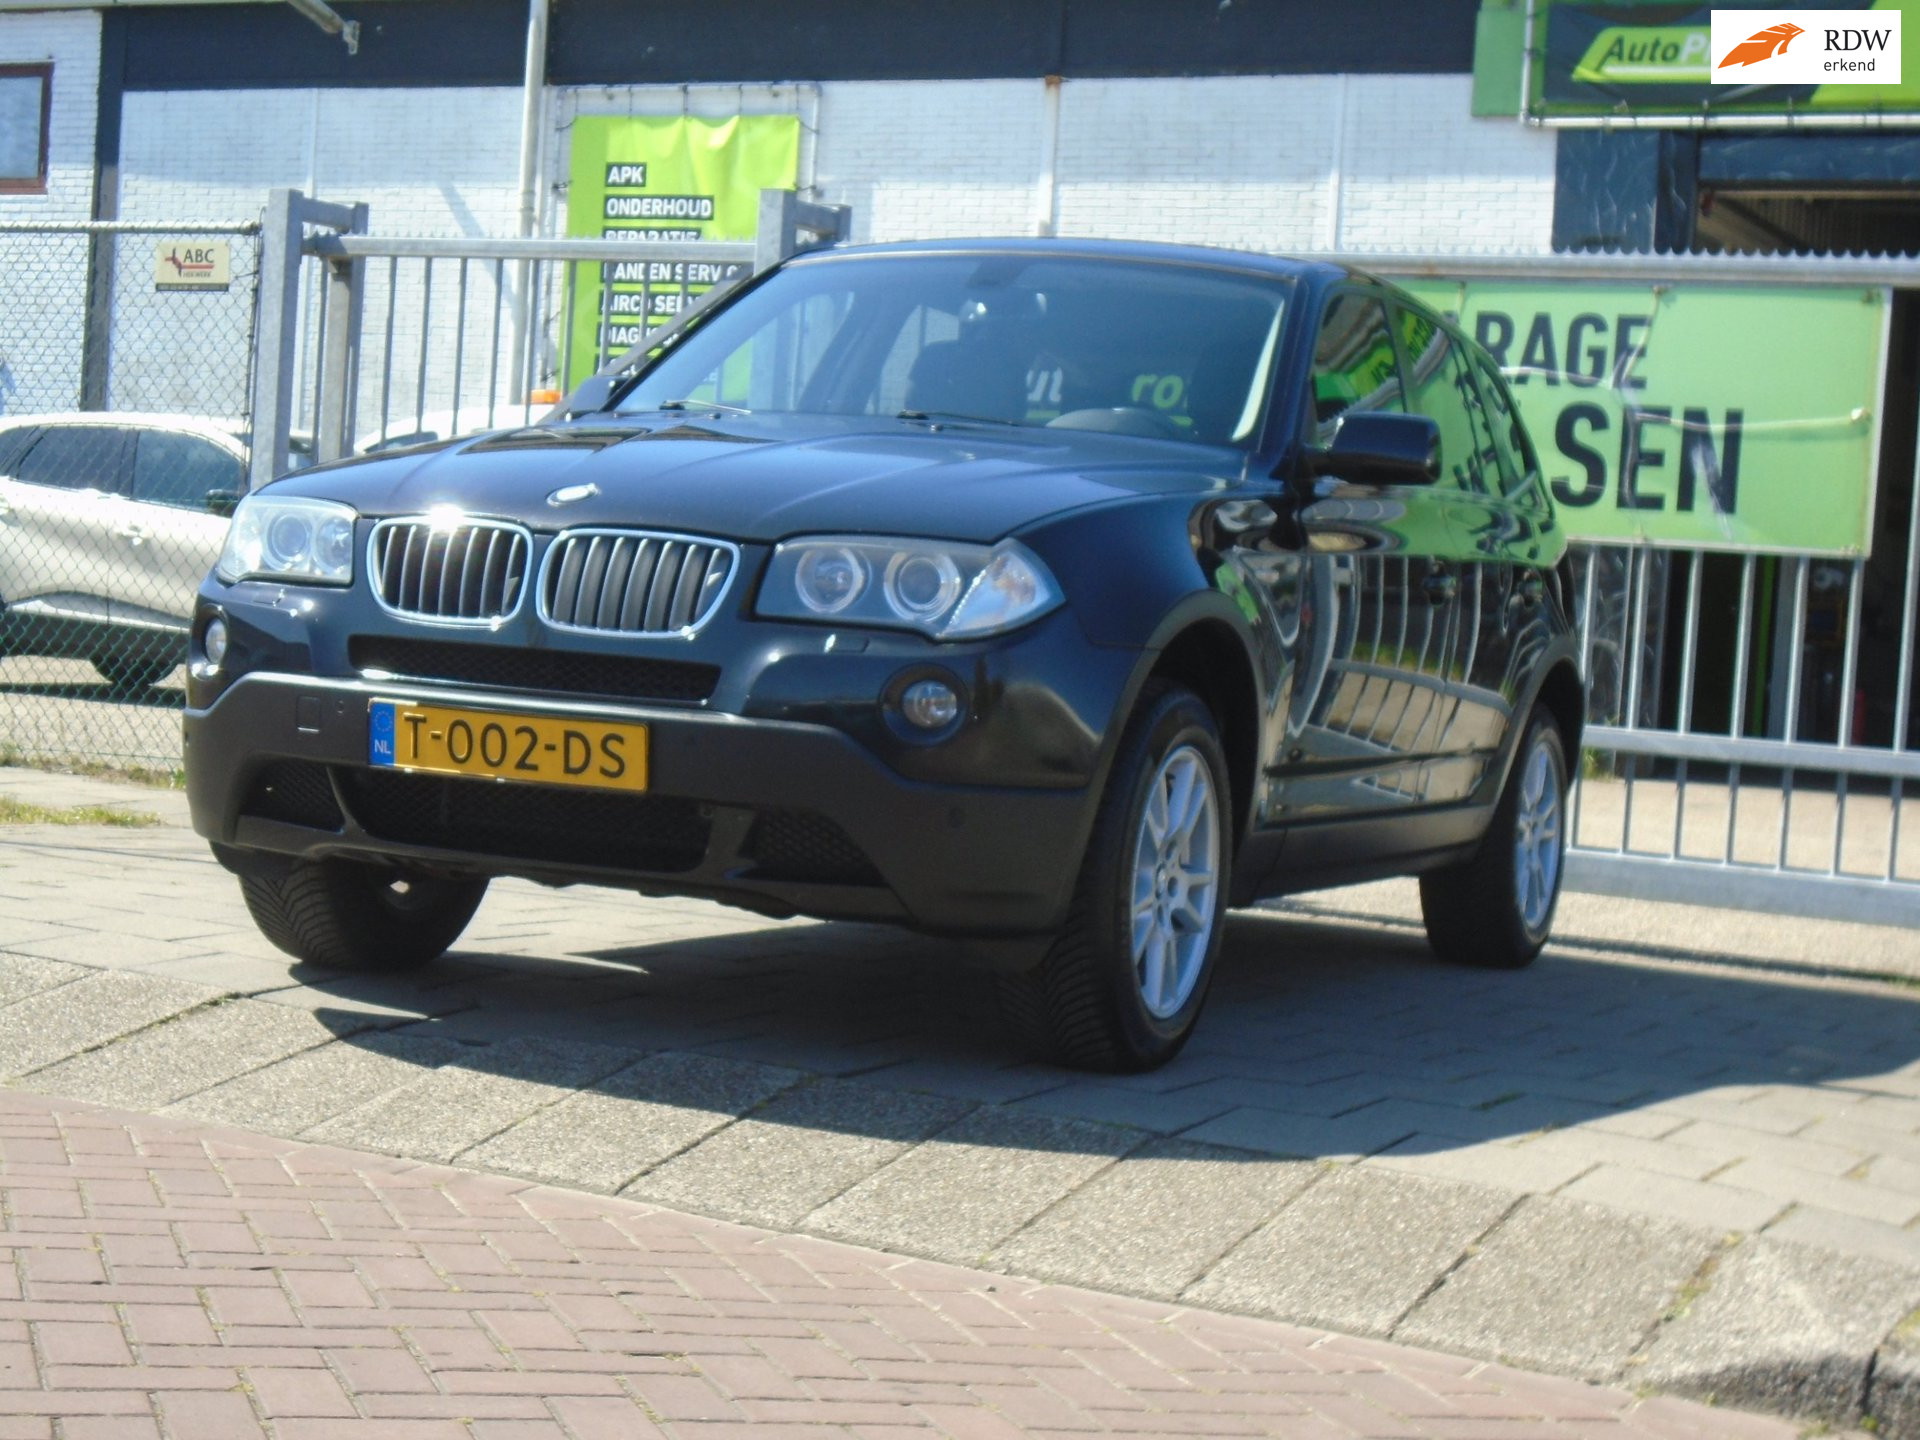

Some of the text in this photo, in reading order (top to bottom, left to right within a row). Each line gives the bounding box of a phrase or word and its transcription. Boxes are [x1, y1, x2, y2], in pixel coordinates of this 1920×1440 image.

[607, 165, 644, 184] APK
[606, 197, 712, 217] ONDERHOUD
[183, 248, 214, 263] ABC
[603, 262, 672, 281] ANDEN
[1474, 310, 1648, 389] RAGE
[1550, 401, 1743, 514] SEN
[374, 739, 391, 754] NL
[403, 711, 627, 779] T-002-DS
